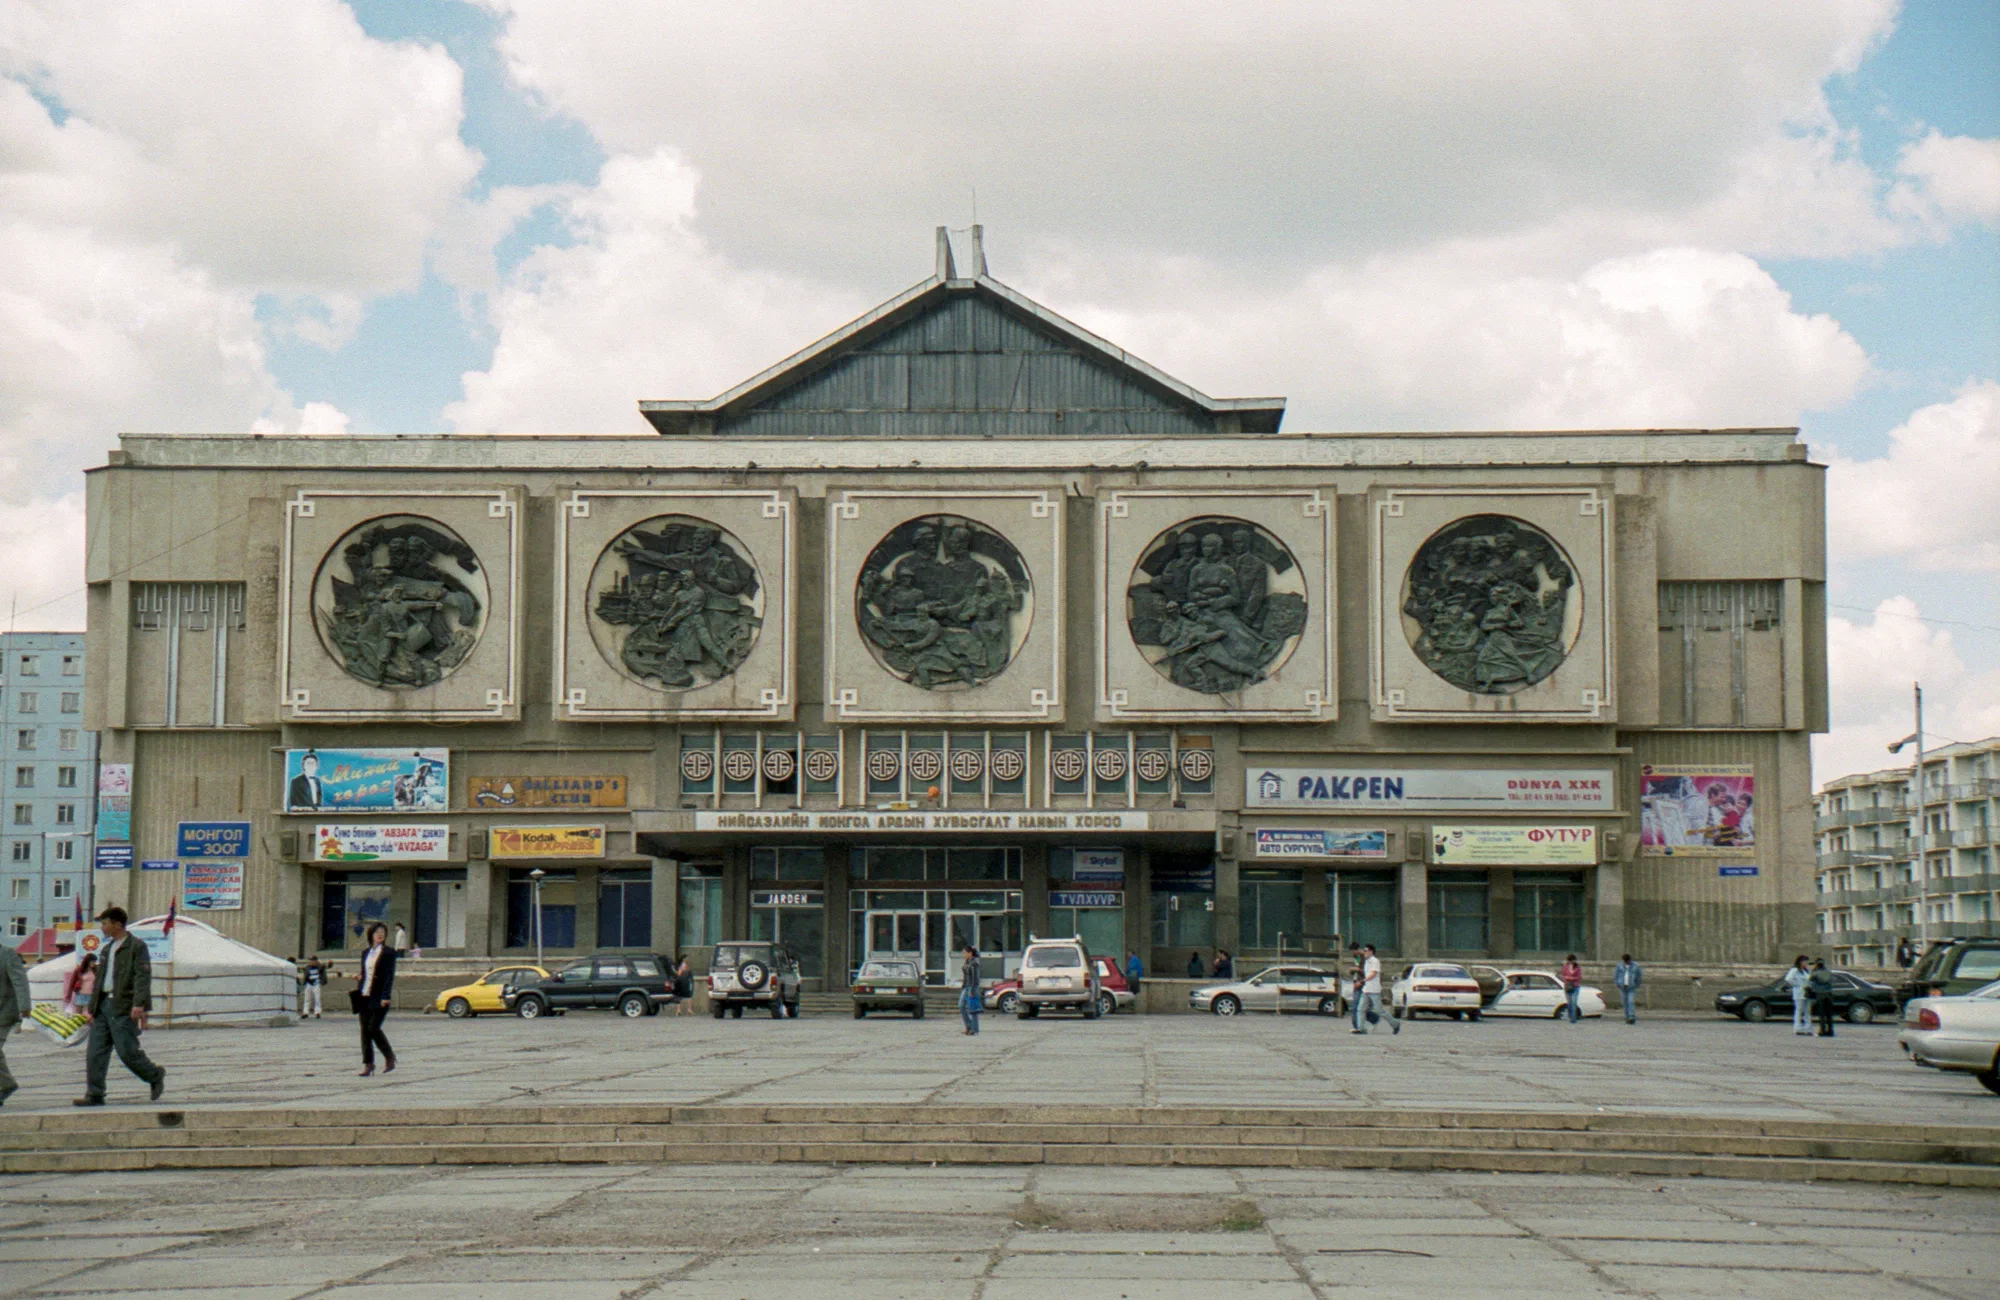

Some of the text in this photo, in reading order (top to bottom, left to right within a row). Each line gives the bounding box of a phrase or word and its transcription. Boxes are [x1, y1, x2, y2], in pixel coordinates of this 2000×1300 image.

[1298, 776, 1404, 800] PAKPEN
[550, 793, 592, 804] CLUB
[819, 815, 870, 828] МОНГОЛ
[877, 815, 926, 828] АРДЫН
[933, 815, 1011, 828] ХУВЬСГАЛТ
[1018, 815, 1067, 828] НАМЫН
[1075, 815, 1122, 828] ХОРОО
[184, 829, 243, 841] МОНГОЛ
[522, 833, 557, 843] Kodak
[1527, 828, 1593, 843] ФУТУР
[203, 843, 241, 854] ЗООГ
